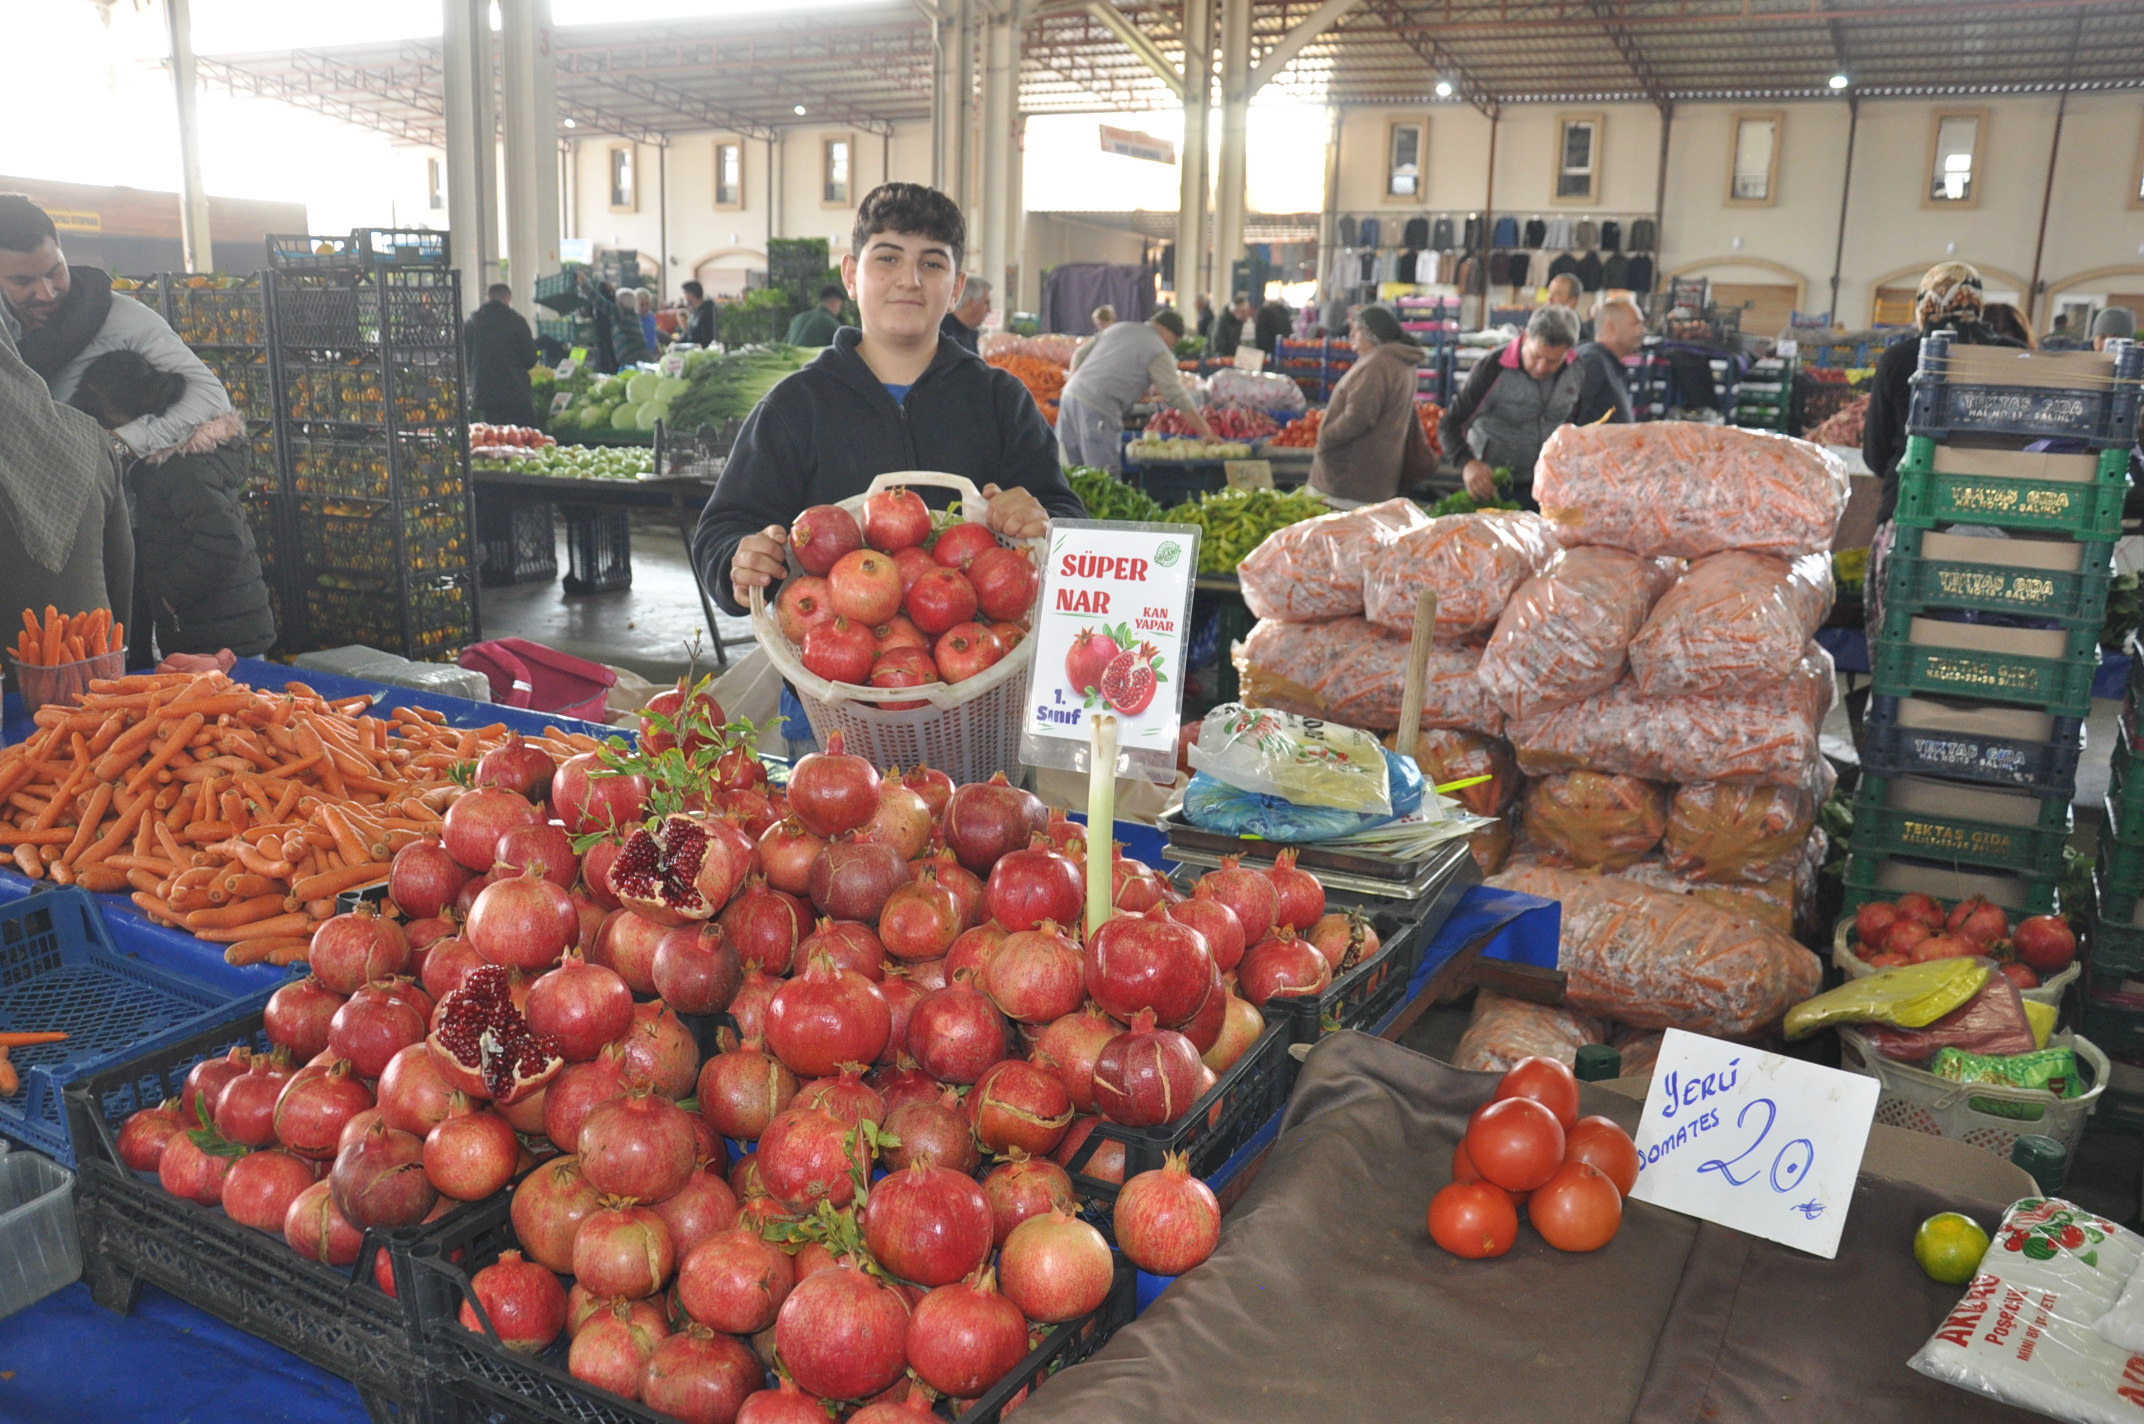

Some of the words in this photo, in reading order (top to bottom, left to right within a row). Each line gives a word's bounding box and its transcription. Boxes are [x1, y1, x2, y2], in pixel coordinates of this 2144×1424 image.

[1153, 544, 1182, 564] ORGANIC
[1060, 550, 1149, 582] SÜPER
[1056, 588, 1111, 615] NAR
[1143, 606, 1169, 619] KAN
[1135, 617, 1174, 632] YAPAR
[1054, 688, 1066, 705] 1.
[1903, 821, 1965, 841] TEKTAS
[1971, 831, 2012, 847] GIDA
[1696, 1098, 1815, 1194] 20
